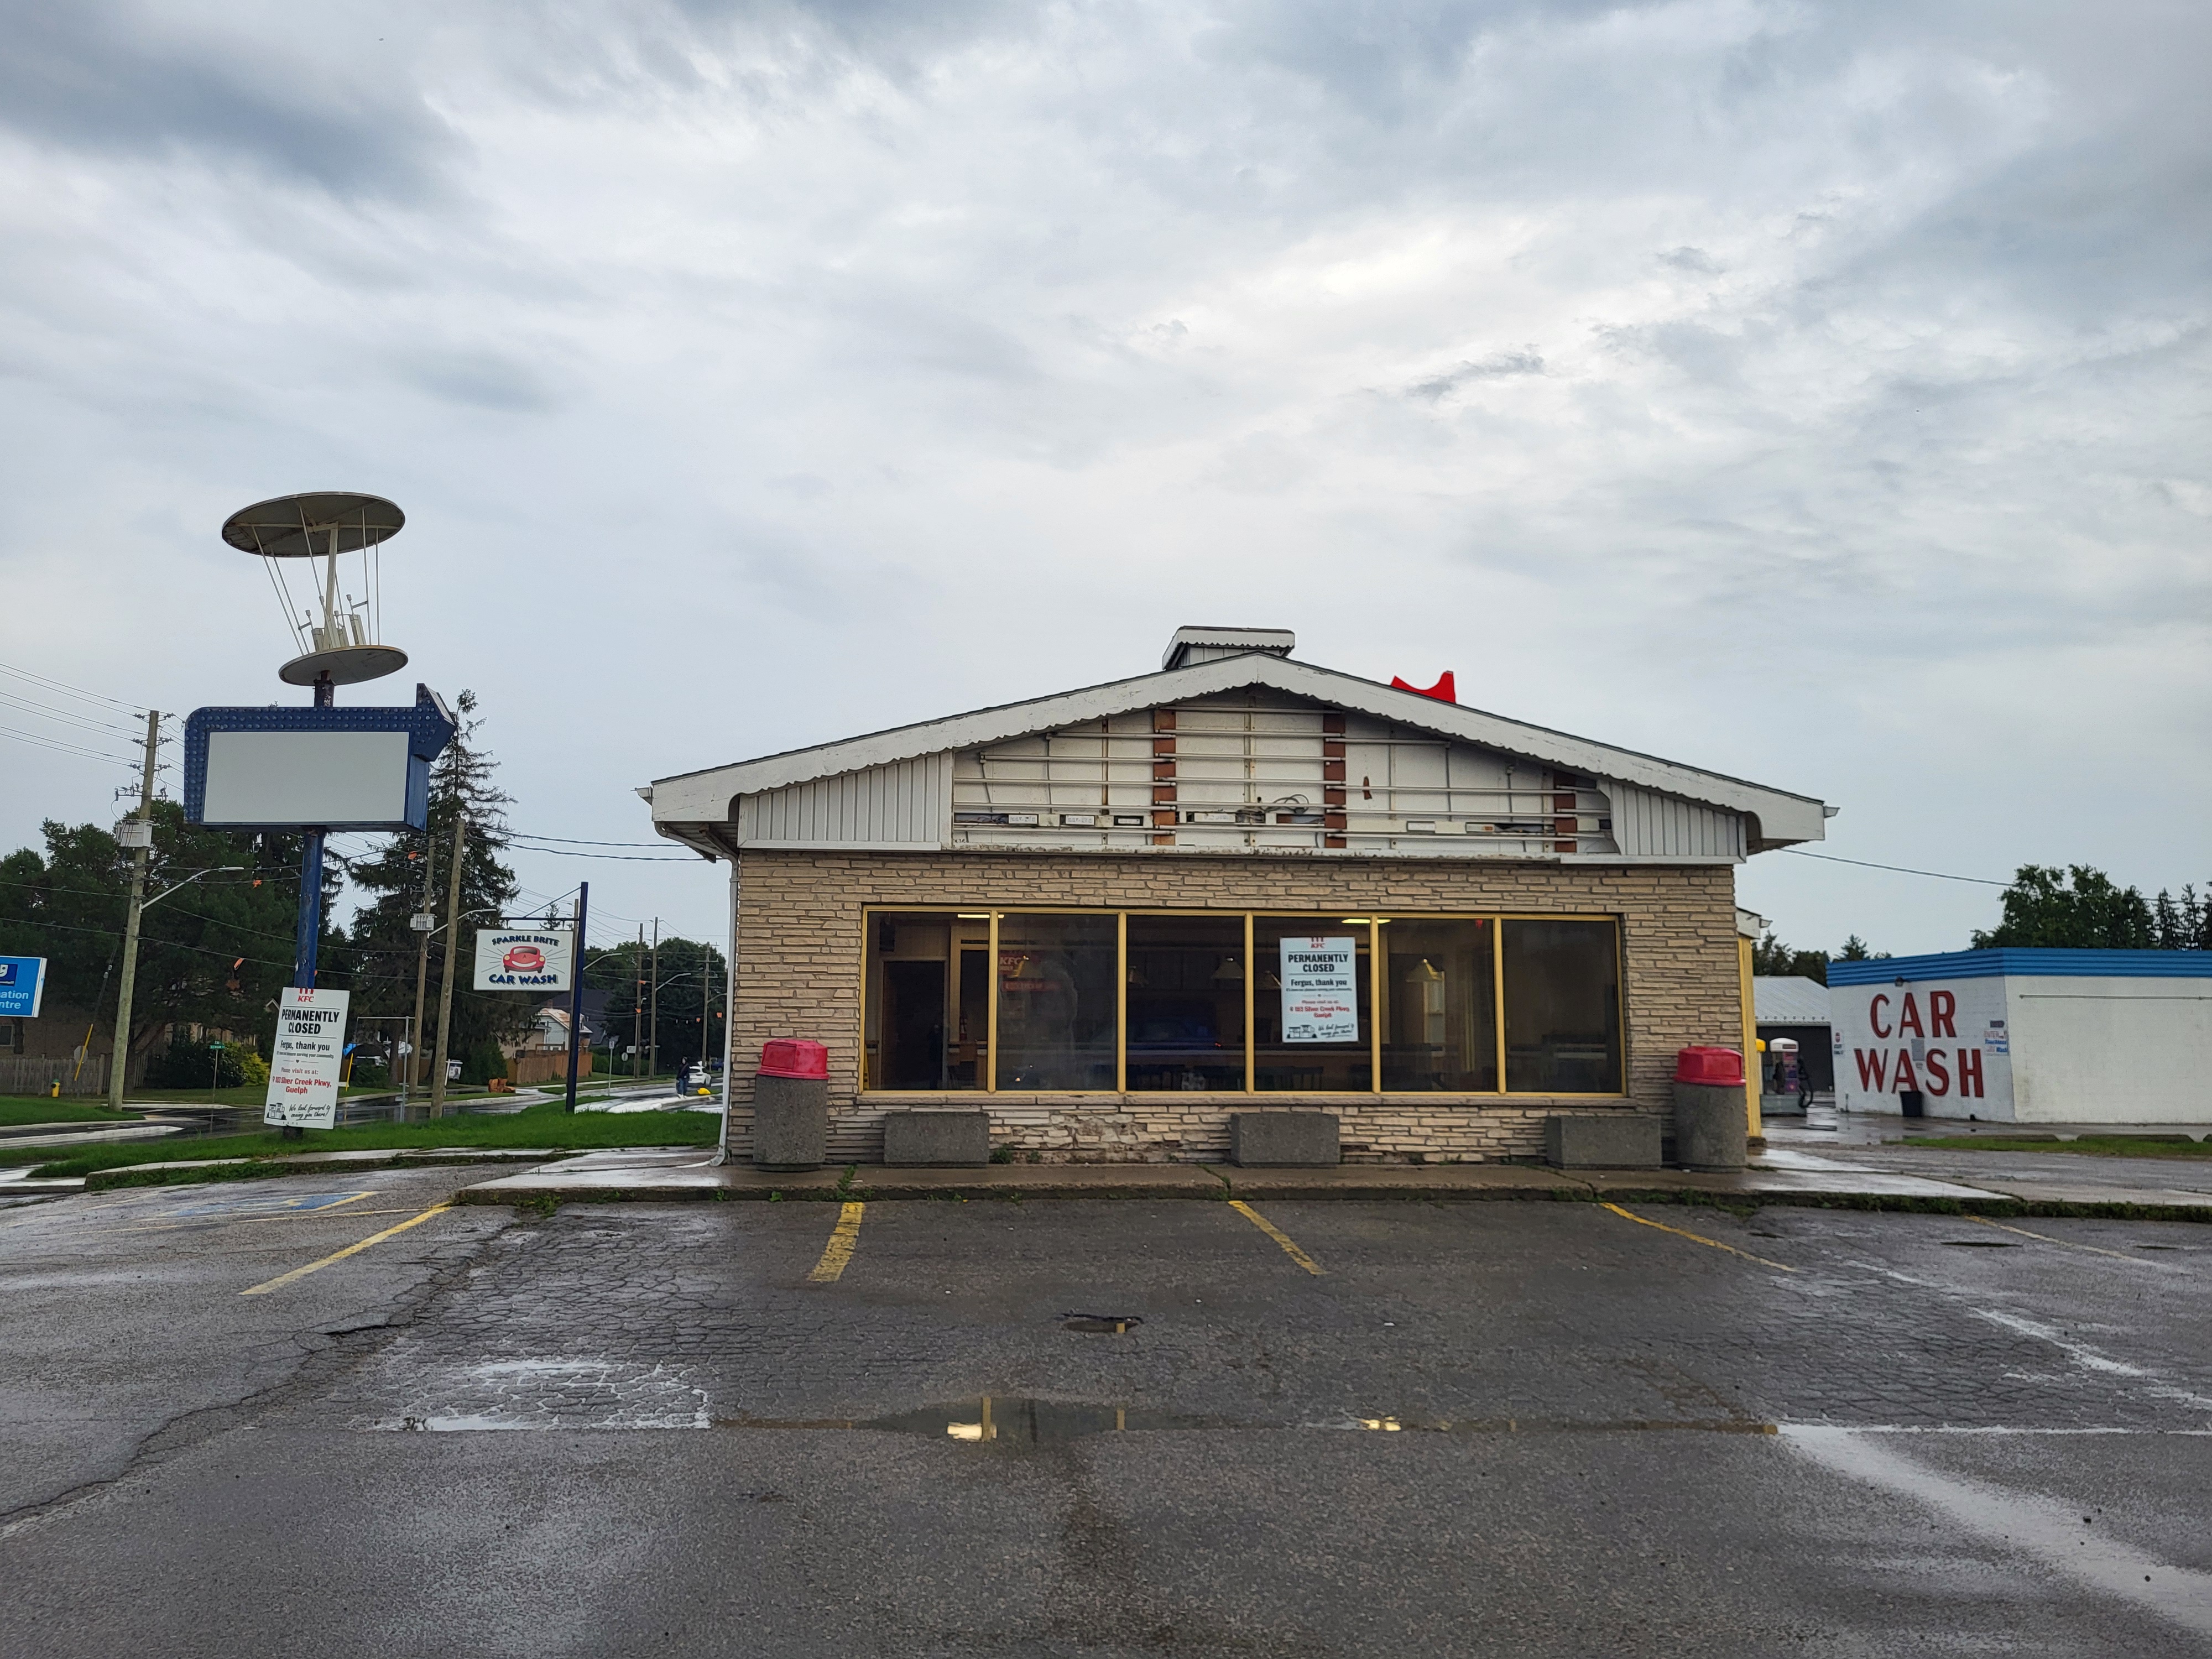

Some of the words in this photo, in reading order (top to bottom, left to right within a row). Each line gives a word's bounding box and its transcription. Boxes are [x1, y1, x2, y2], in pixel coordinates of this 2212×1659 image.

[492, 935, 532, 946] SPARKLE
[534, 936, 560, 947] BRITE
[999, 957, 1021, 965] KFC
[1288, 954, 1348, 963] PERMANENTLY
[1303, 964, 1334, 972] CLOSED
[488, 974, 516, 985] CAR
[519, 974, 559, 986] WASH
[1291, 979, 1314, 987] Fergus,
[0, 990, 29, 999] ation
[281, 1009, 340, 1022] PERMANENTLY
[1870, 990, 1957, 1039] CAR
[288, 1022, 321, 1034] CLOSED
[280, 1040, 294, 1050] Fergus,
[296, 1041, 316, 1050] thank
[1854, 1048, 1984, 1098] WASH
[314, 1079, 332, 1088] Pkwy,
[286, 1086, 308, 1095] Guelph
[307, 1104, 326, 1113] forward
